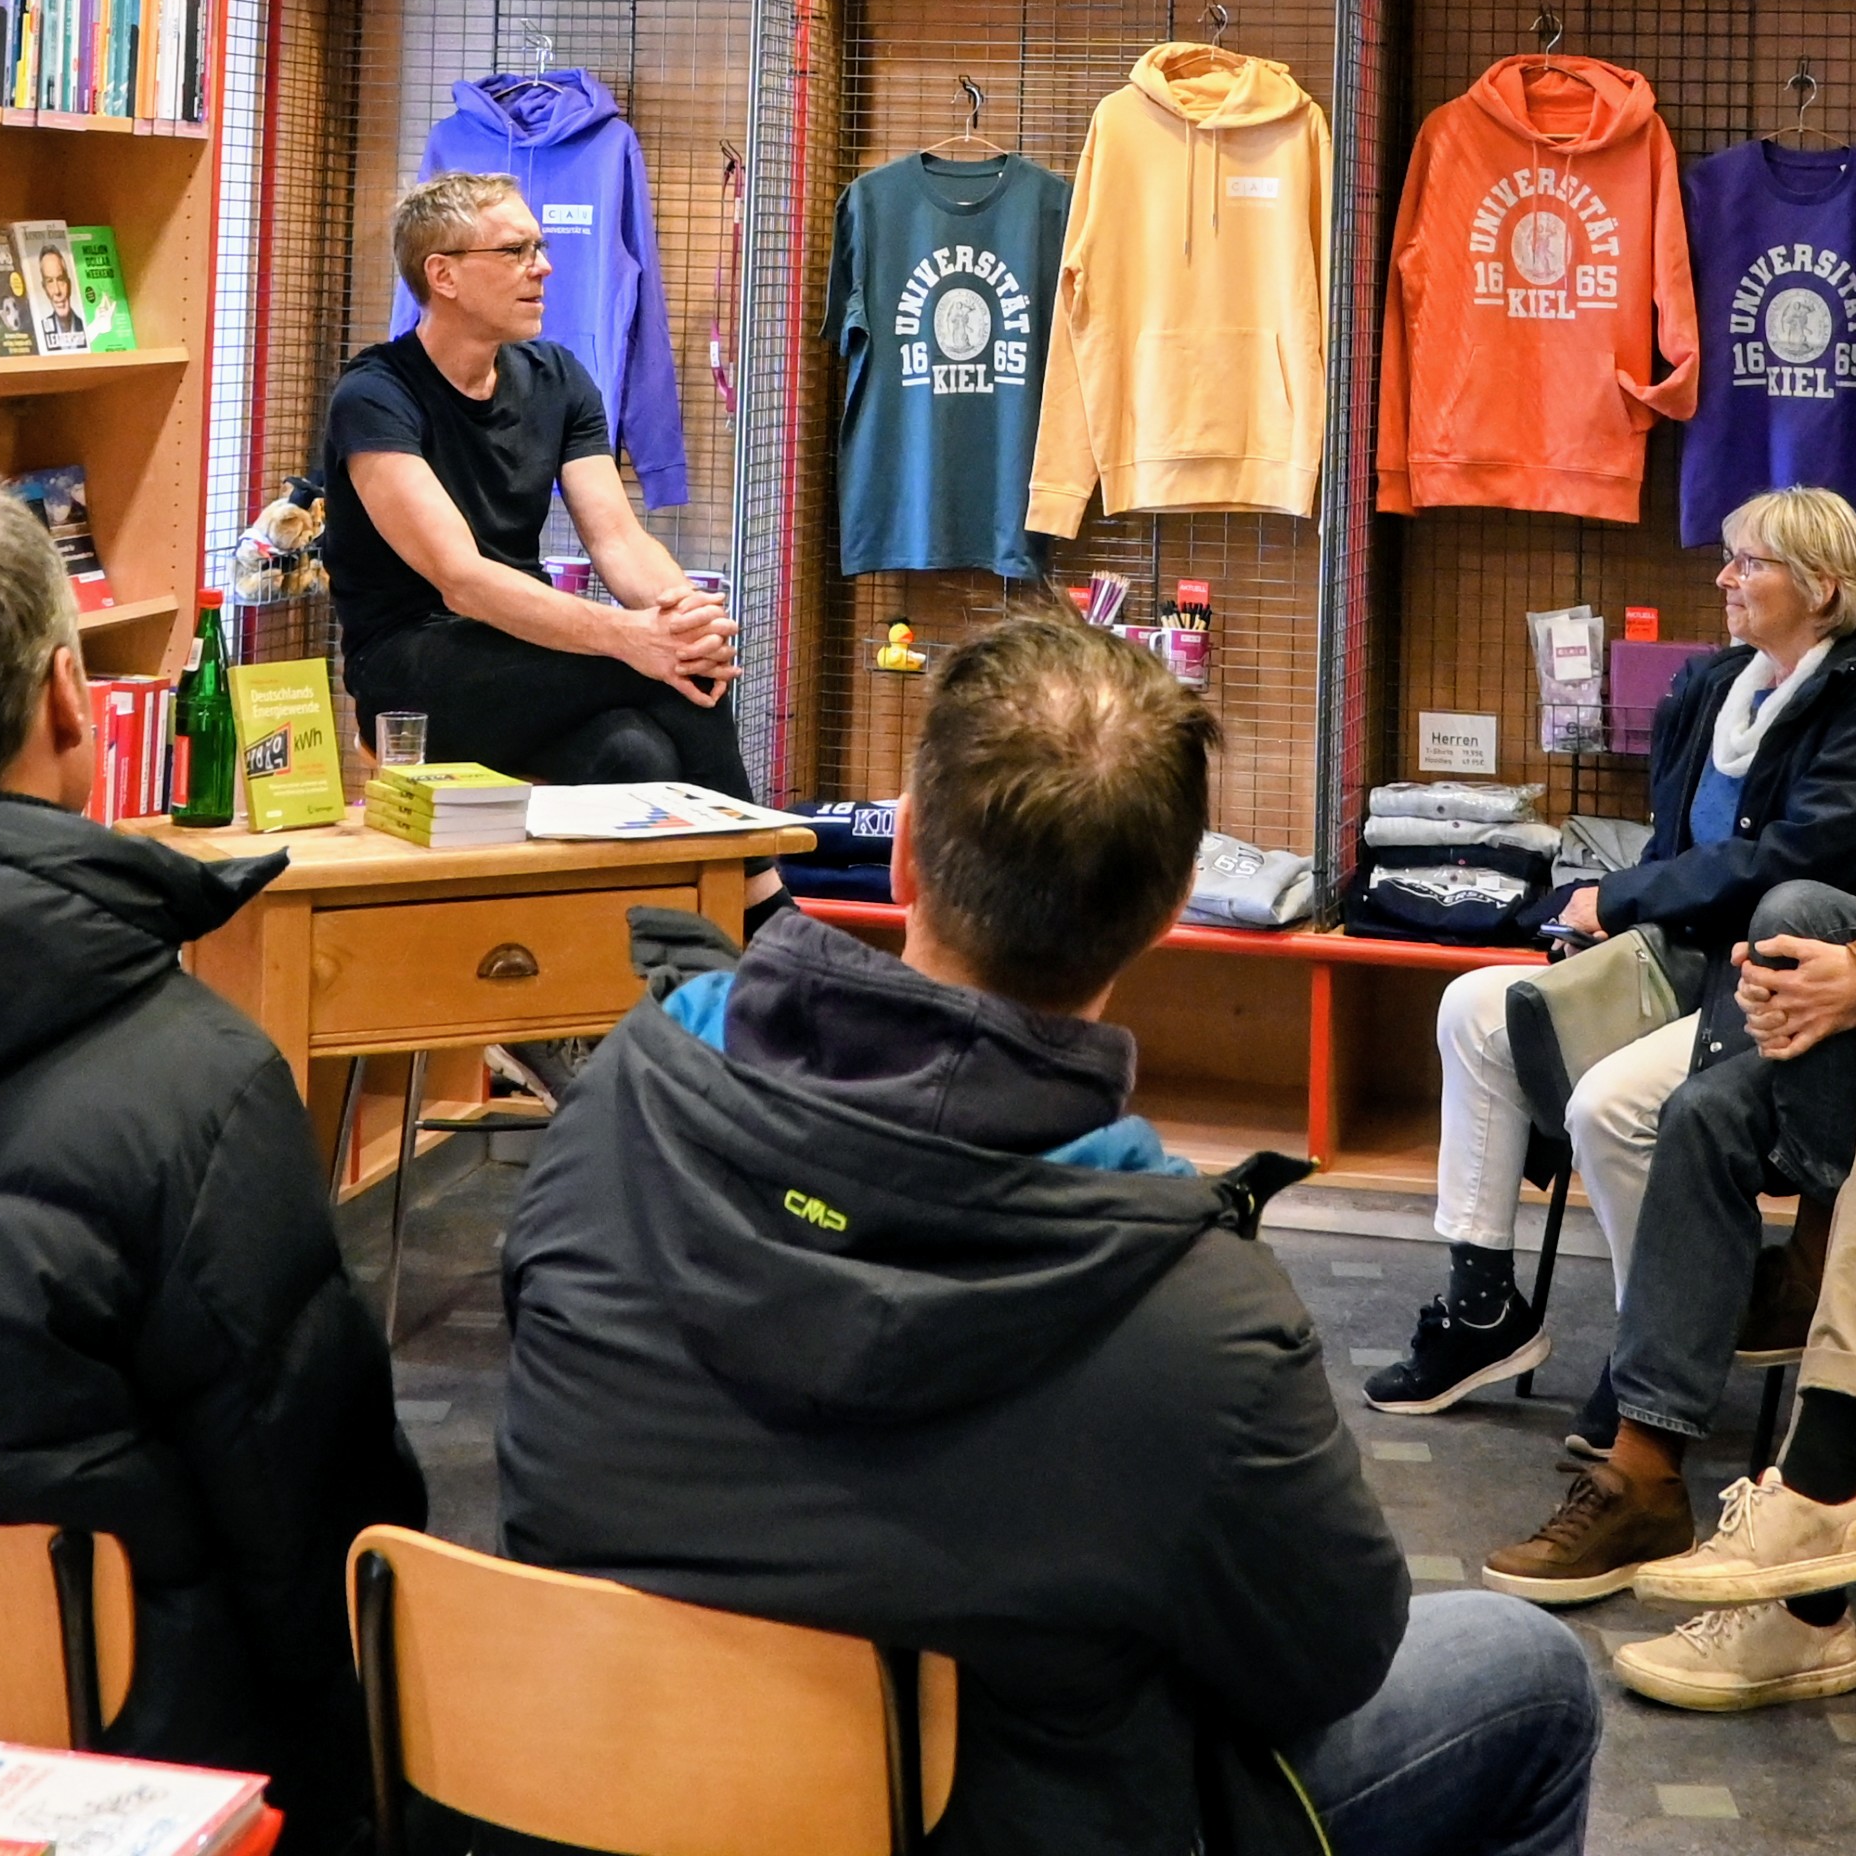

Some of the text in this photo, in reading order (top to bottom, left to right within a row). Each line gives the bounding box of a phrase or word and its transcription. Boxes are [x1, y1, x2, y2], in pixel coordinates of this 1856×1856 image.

[1469, 167, 1620, 256] UNIVERSITÄT
[82, 245, 109, 255] MILLION
[85, 256, 111, 267] DOLLAR
[85, 268, 114, 279] WEEKEND
[1474, 261, 1617, 297] 16 65
[895, 245, 1030, 335] UNIVERSITÄT
[1507, 288, 1575, 319] KIEL
[900, 340, 1027, 375] 16 65
[1733, 342, 1765, 375] 16
[932, 364, 994, 394] KIEL
[1766, 366, 1834, 398] KIEL
[1179, 584, 1208, 593] AKTUELL
[250, 686, 314, 703] Deutschlands
[252, 701, 321, 720] Energiewende
[294, 728, 322, 753] kWh
[1431, 731, 1479, 747] Herren
[816, 801, 857, 815] 16
[784, 1189, 847, 1232] CMP
